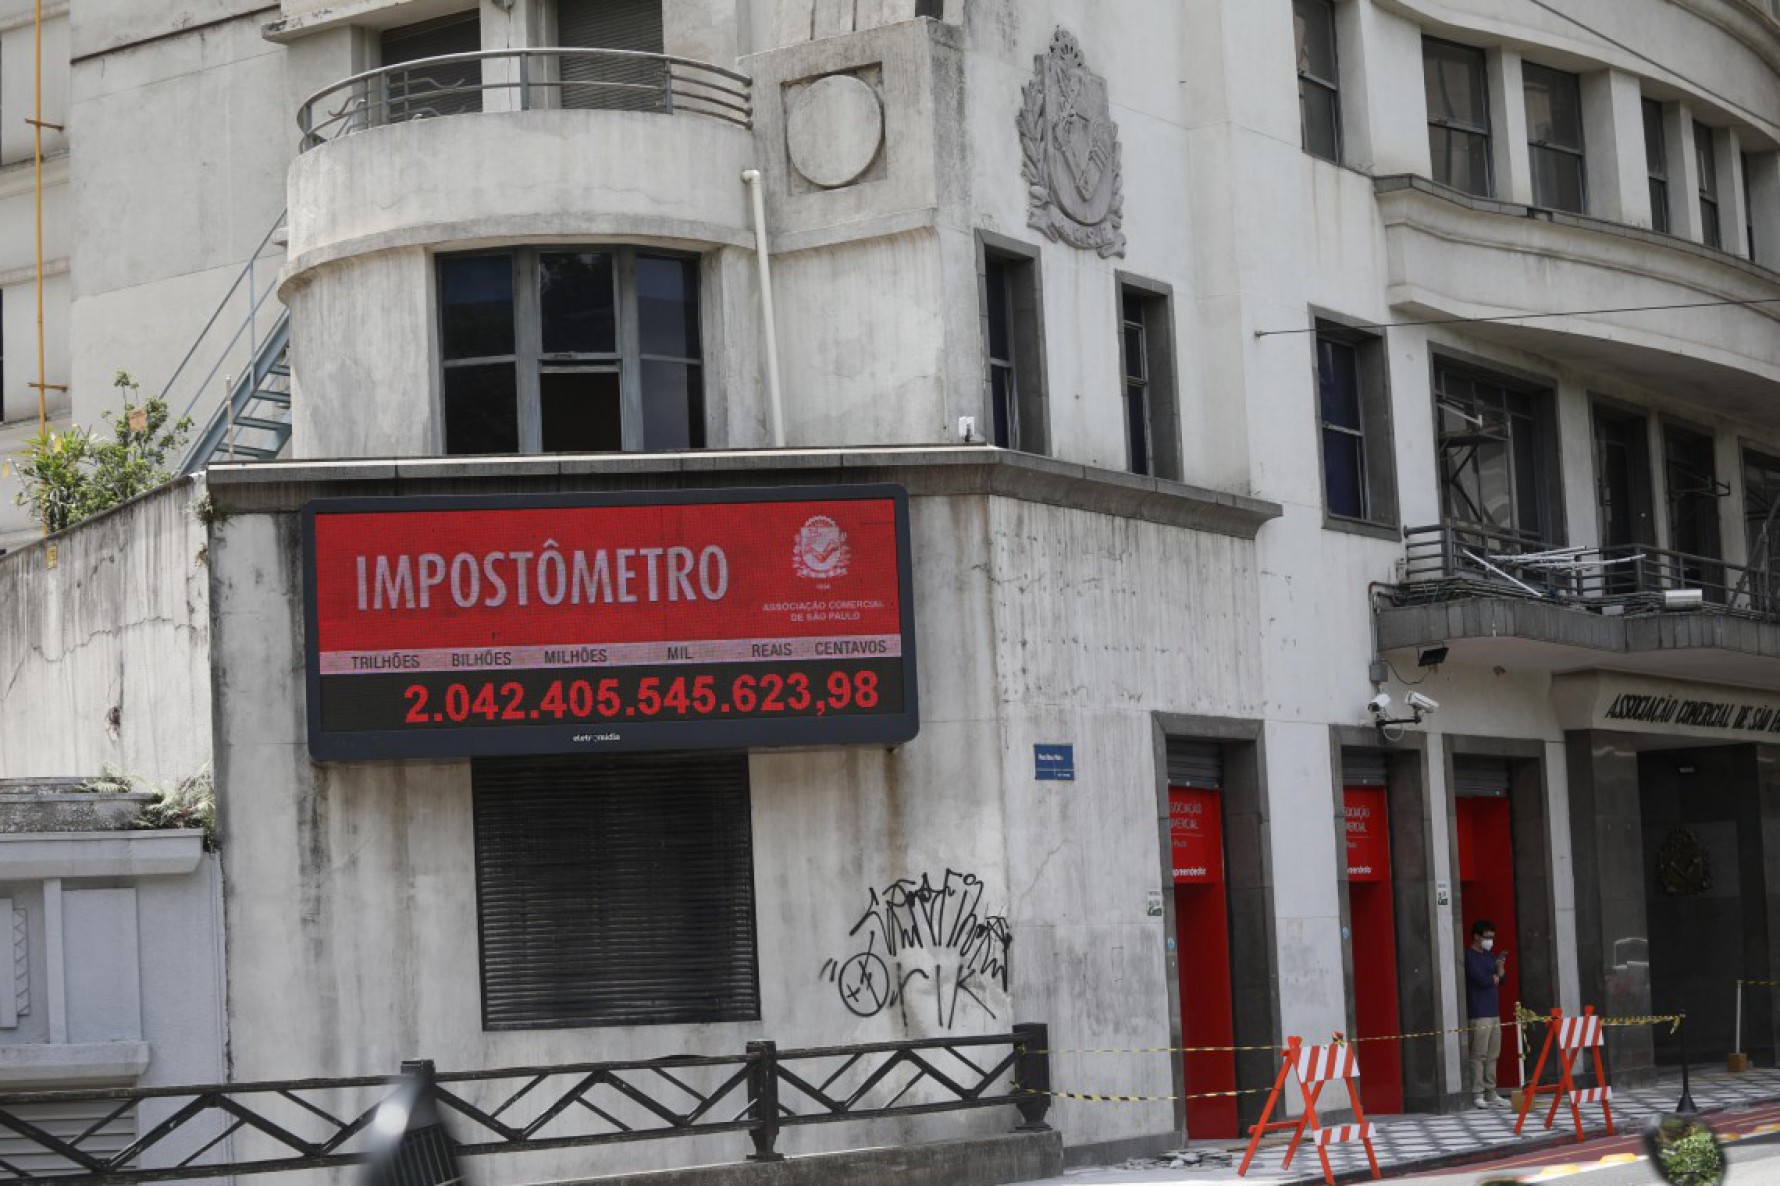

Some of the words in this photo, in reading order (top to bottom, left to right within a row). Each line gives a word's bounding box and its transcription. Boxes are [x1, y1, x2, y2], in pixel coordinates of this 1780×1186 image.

[356, 538, 729, 611] IMPOSTÔMETRO
[763, 600, 826, 612] ASSOCIAÇÃO
[828, 600, 884, 609] COMERCIAL
[790, 612, 804, 622] DE
[806, 610, 827, 621] SÃO
[828, 611, 860, 621] PAULO
[351, 653, 421, 670] TRILHÕES
[452, 650, 512, 667] BILHÕES
[544, 646, 609, 664] MILHÕES
[667, 646, 694, 661] MIL
[752, 642, 793, 658] REAIS
[814, 639, 888, 656] CENTAVOS
[403, 670, 880, 724] 2.042.405.545.623,98
